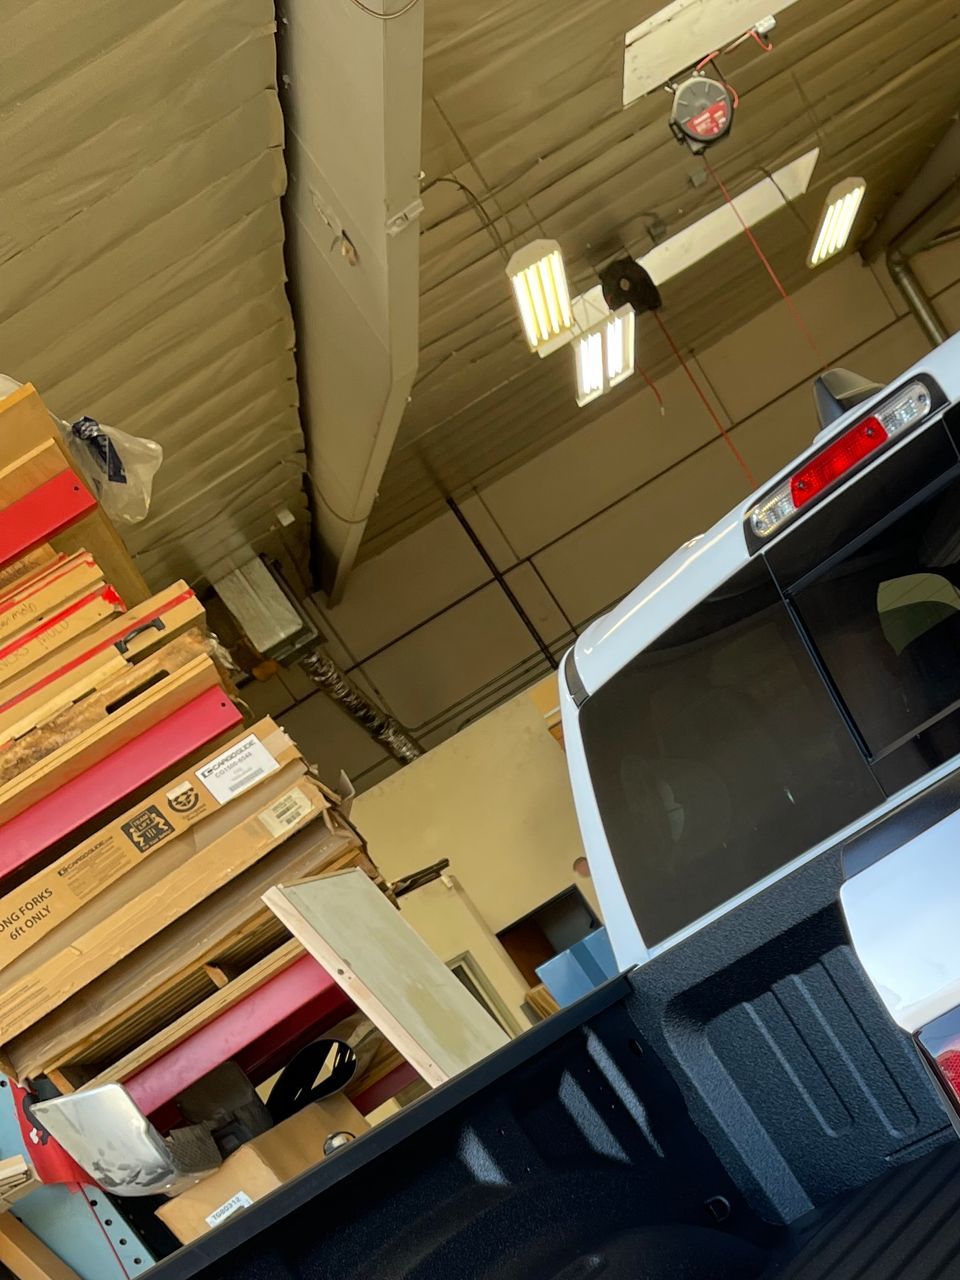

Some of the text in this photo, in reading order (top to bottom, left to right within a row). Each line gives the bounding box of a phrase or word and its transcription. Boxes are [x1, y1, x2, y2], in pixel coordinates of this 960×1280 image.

[18, 887, 53, 916] FORKS
[9, 905, 52, 941] 6ft ONLY
